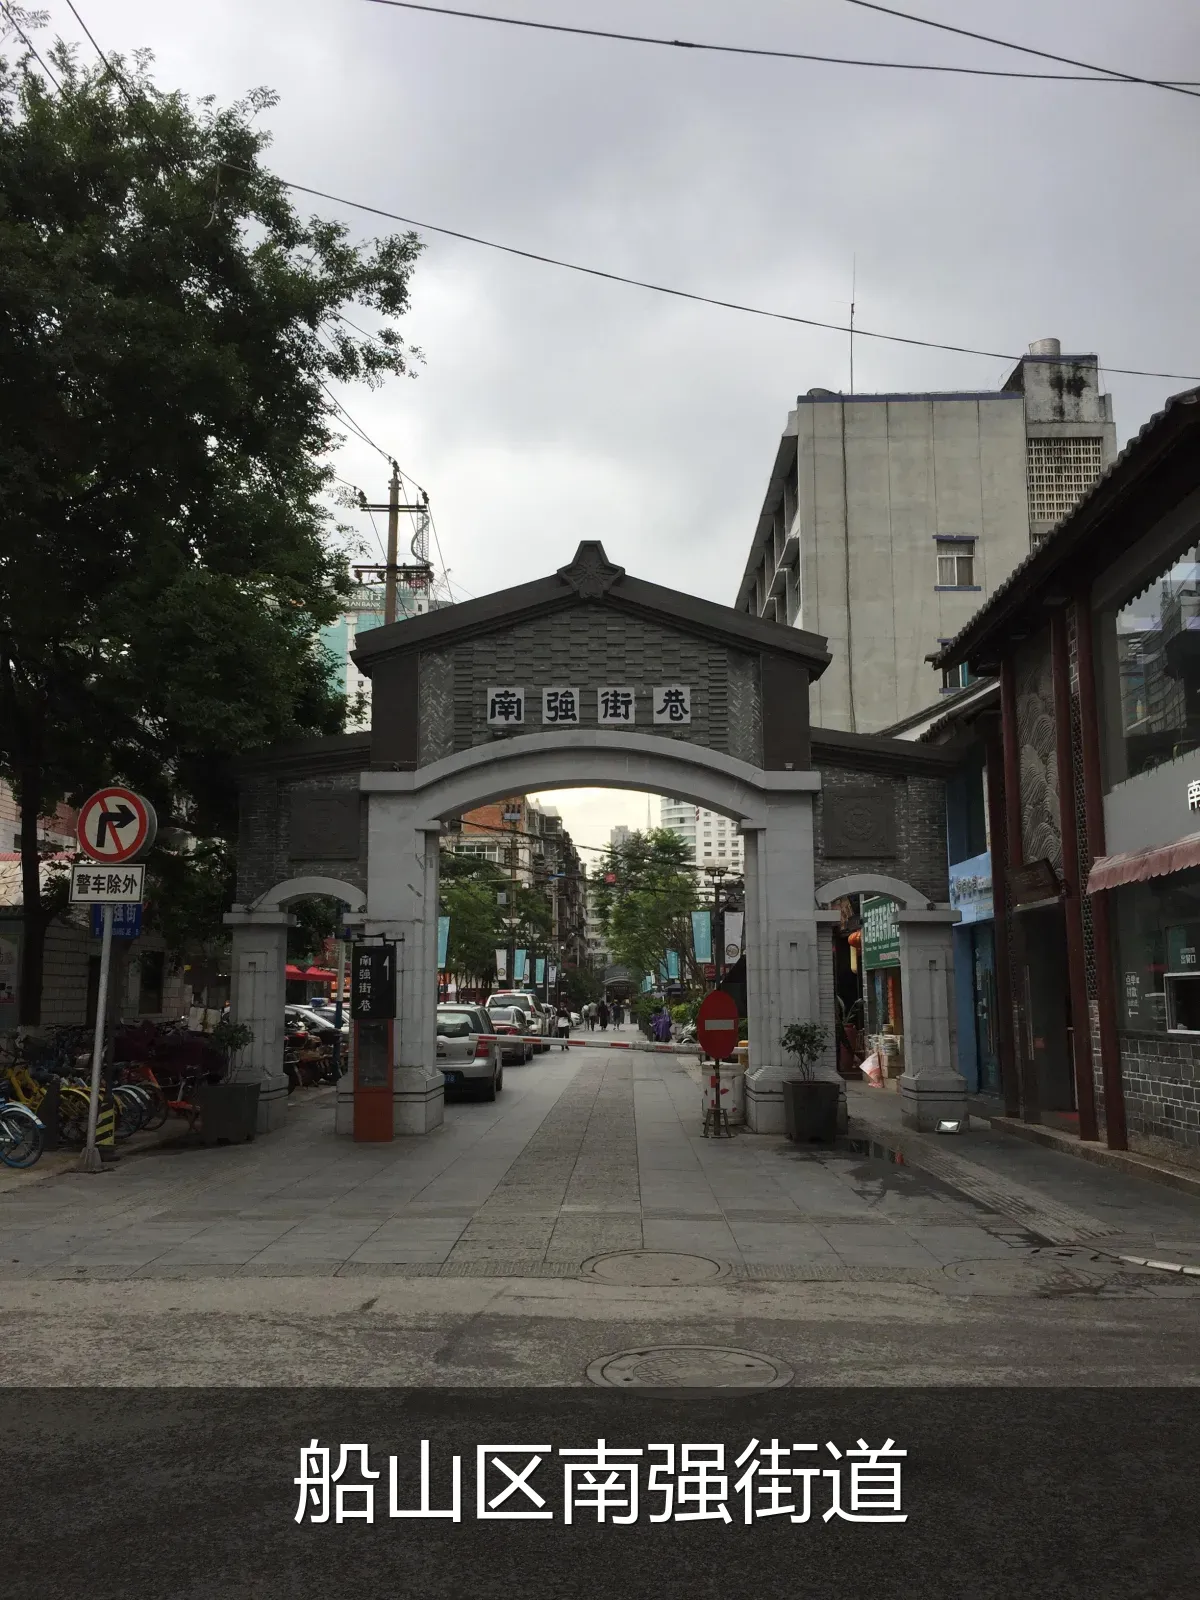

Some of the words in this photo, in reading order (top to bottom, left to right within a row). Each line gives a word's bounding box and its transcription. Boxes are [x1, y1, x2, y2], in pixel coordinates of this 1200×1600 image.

[489, 689, 690, 722] 南強街巷
[76, 874, 138, 895] 警车除外
[358, 954, 372, 1012] 南強街巷
